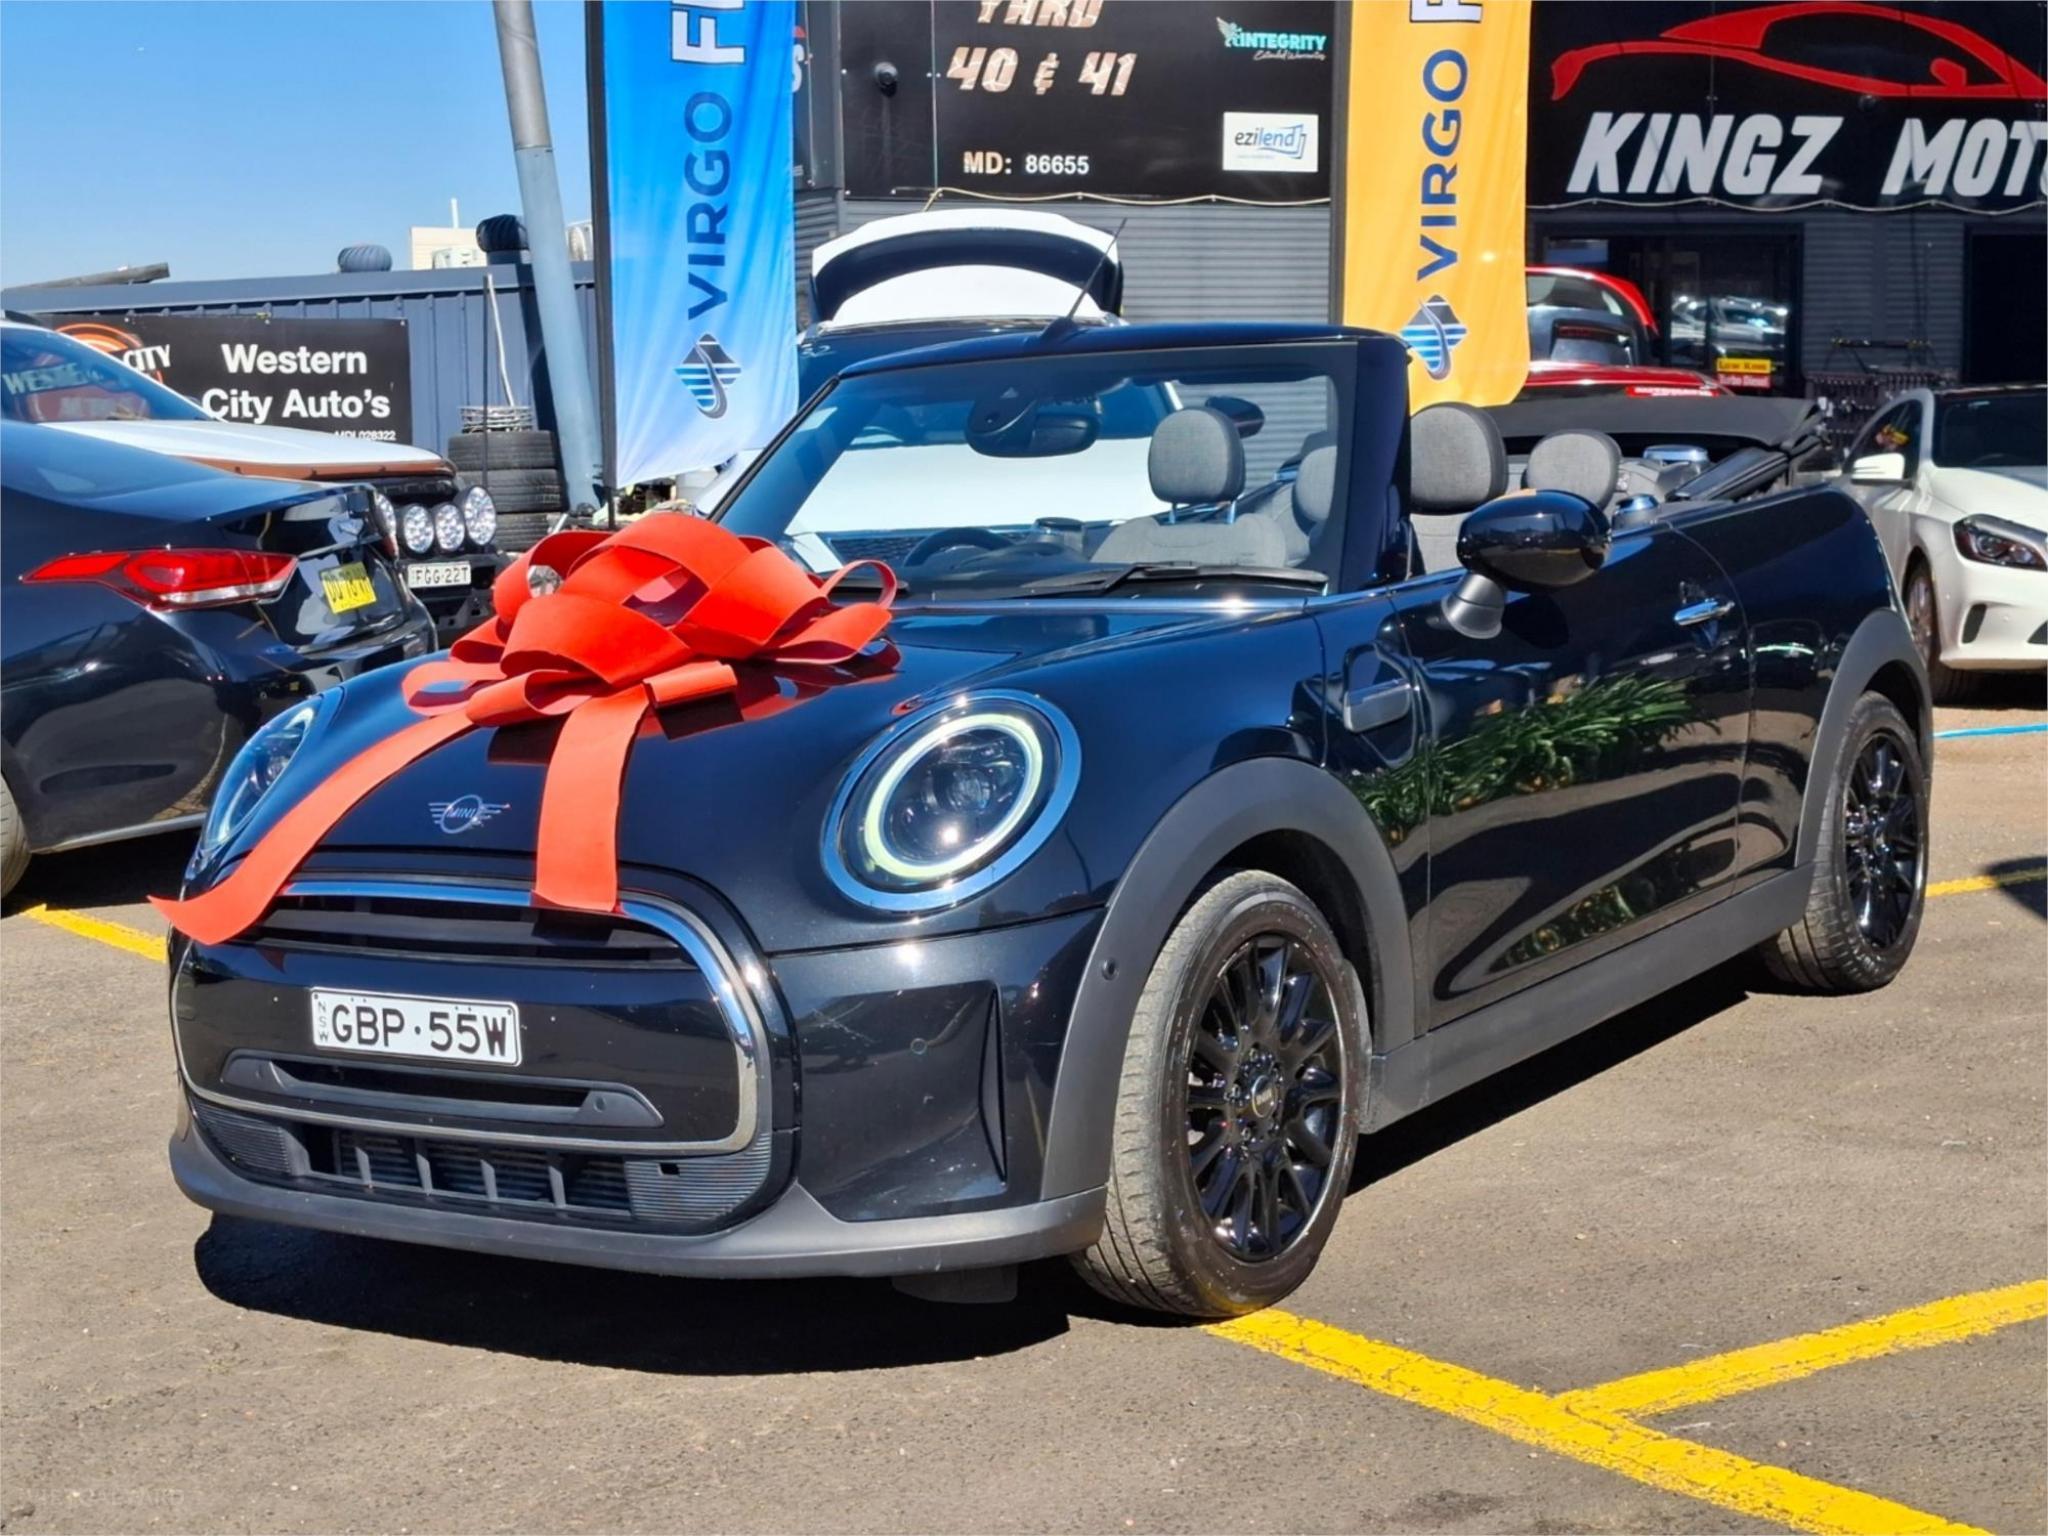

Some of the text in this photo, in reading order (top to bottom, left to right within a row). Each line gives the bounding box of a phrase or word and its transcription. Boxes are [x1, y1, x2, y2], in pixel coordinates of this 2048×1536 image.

[1239, 32, 1327, 51] INTEGRITY
[946, 46, 1019, 93] 40
[1078, 52, 1137, 96] 41
[1234, 126, 1297, 147] ezilend
[963, 151, 1090, 174] MD: 86655
[1416, 48, 1468, 282] VIRGO
[1566, 112, 2048, 197] KINGZ MOT
[684, 91, 732, 320] VIRGO
[123, 344, 171, 371] CITY
[221, 343, 368, 375] Western
[202, 388, 391, 425] City Auto's
